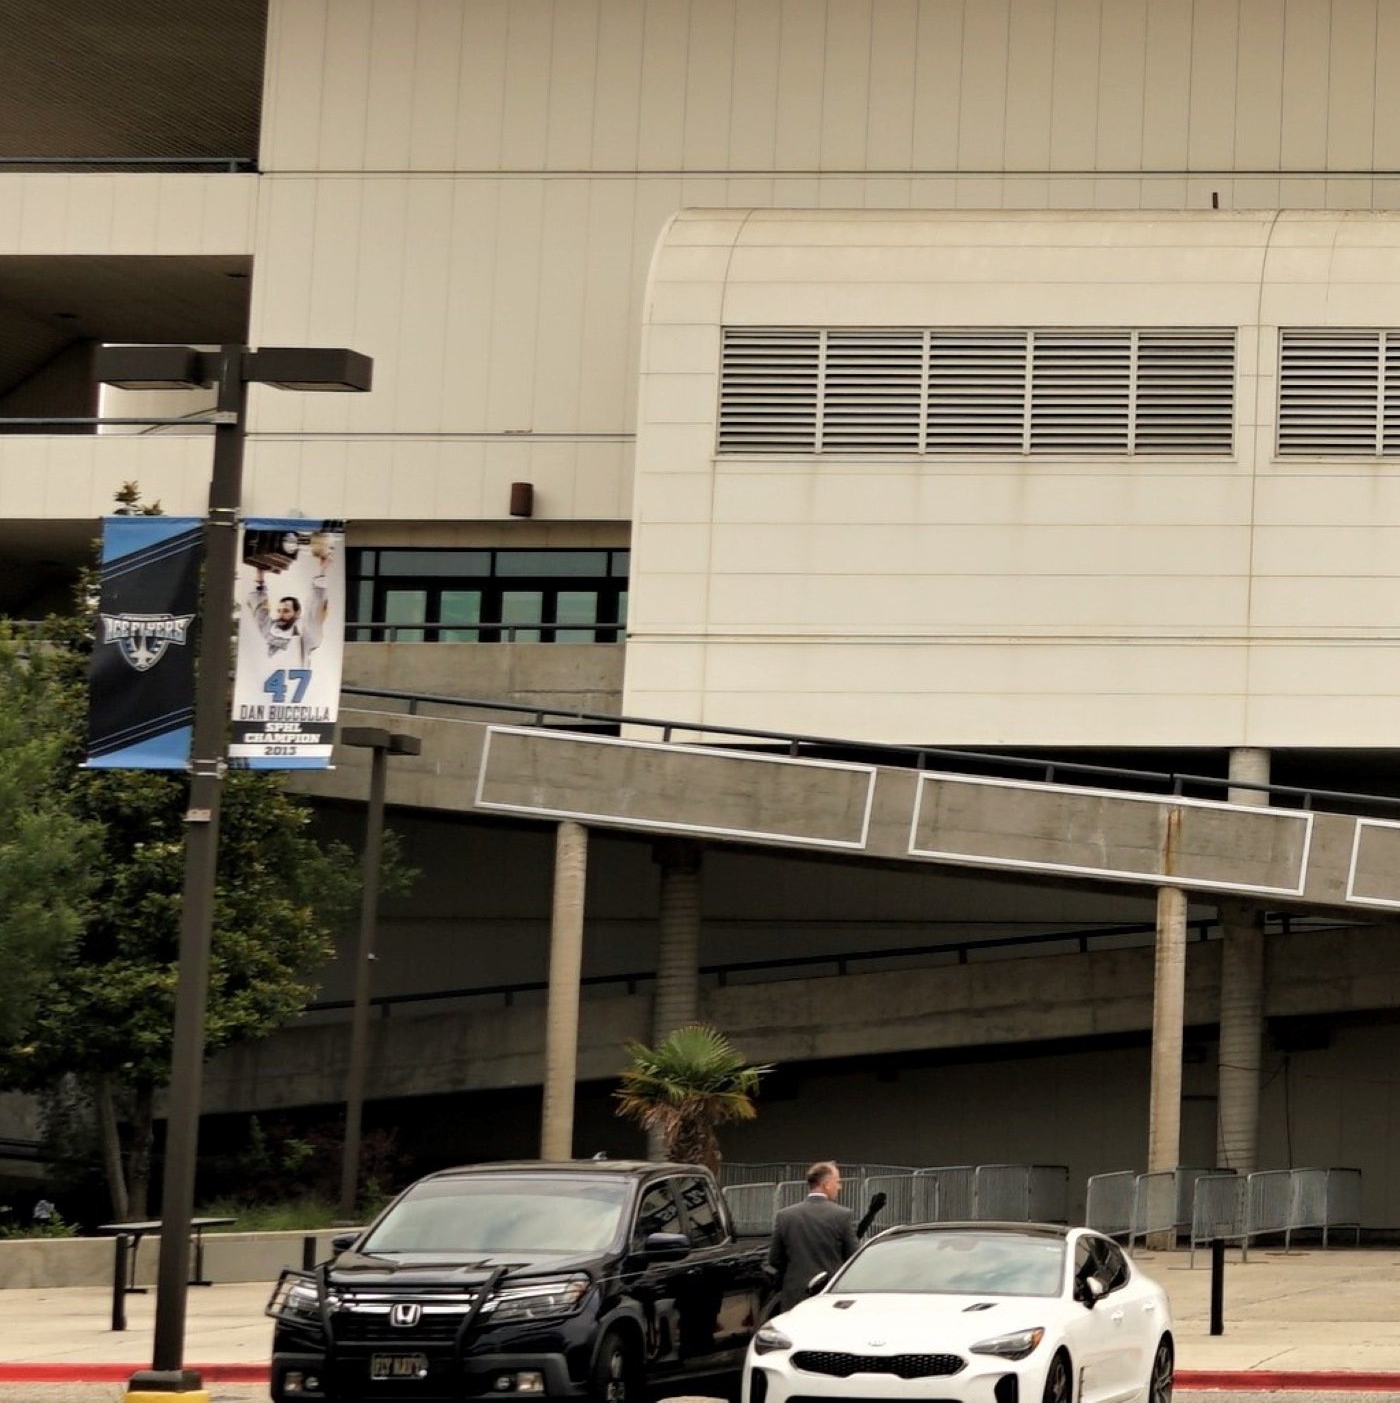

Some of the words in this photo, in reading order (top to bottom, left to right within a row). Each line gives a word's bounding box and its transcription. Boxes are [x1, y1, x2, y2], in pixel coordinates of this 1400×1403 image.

[264, 669, 312, 704] 47
[240, 705, 265, 720] DAN
[244, 733, 321, 744] CHAMPION
[264, 746, 298, 756] 2013
